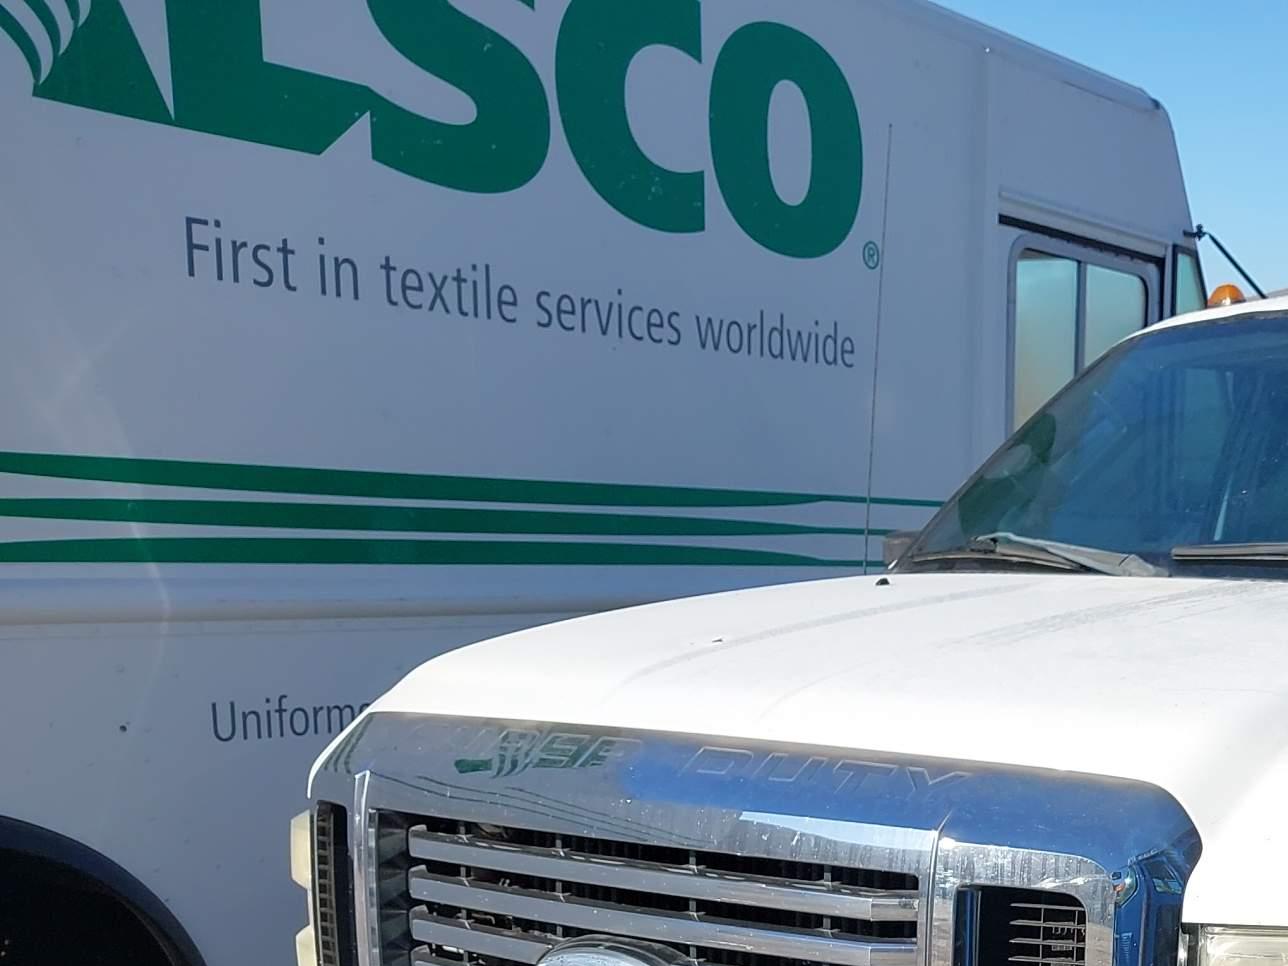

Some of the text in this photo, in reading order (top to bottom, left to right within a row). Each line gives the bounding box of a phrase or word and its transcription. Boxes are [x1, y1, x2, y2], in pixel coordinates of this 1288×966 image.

[184, 216, 856, 369] First in textile services worldwide
[682, 745, 974, 798] DUTY
